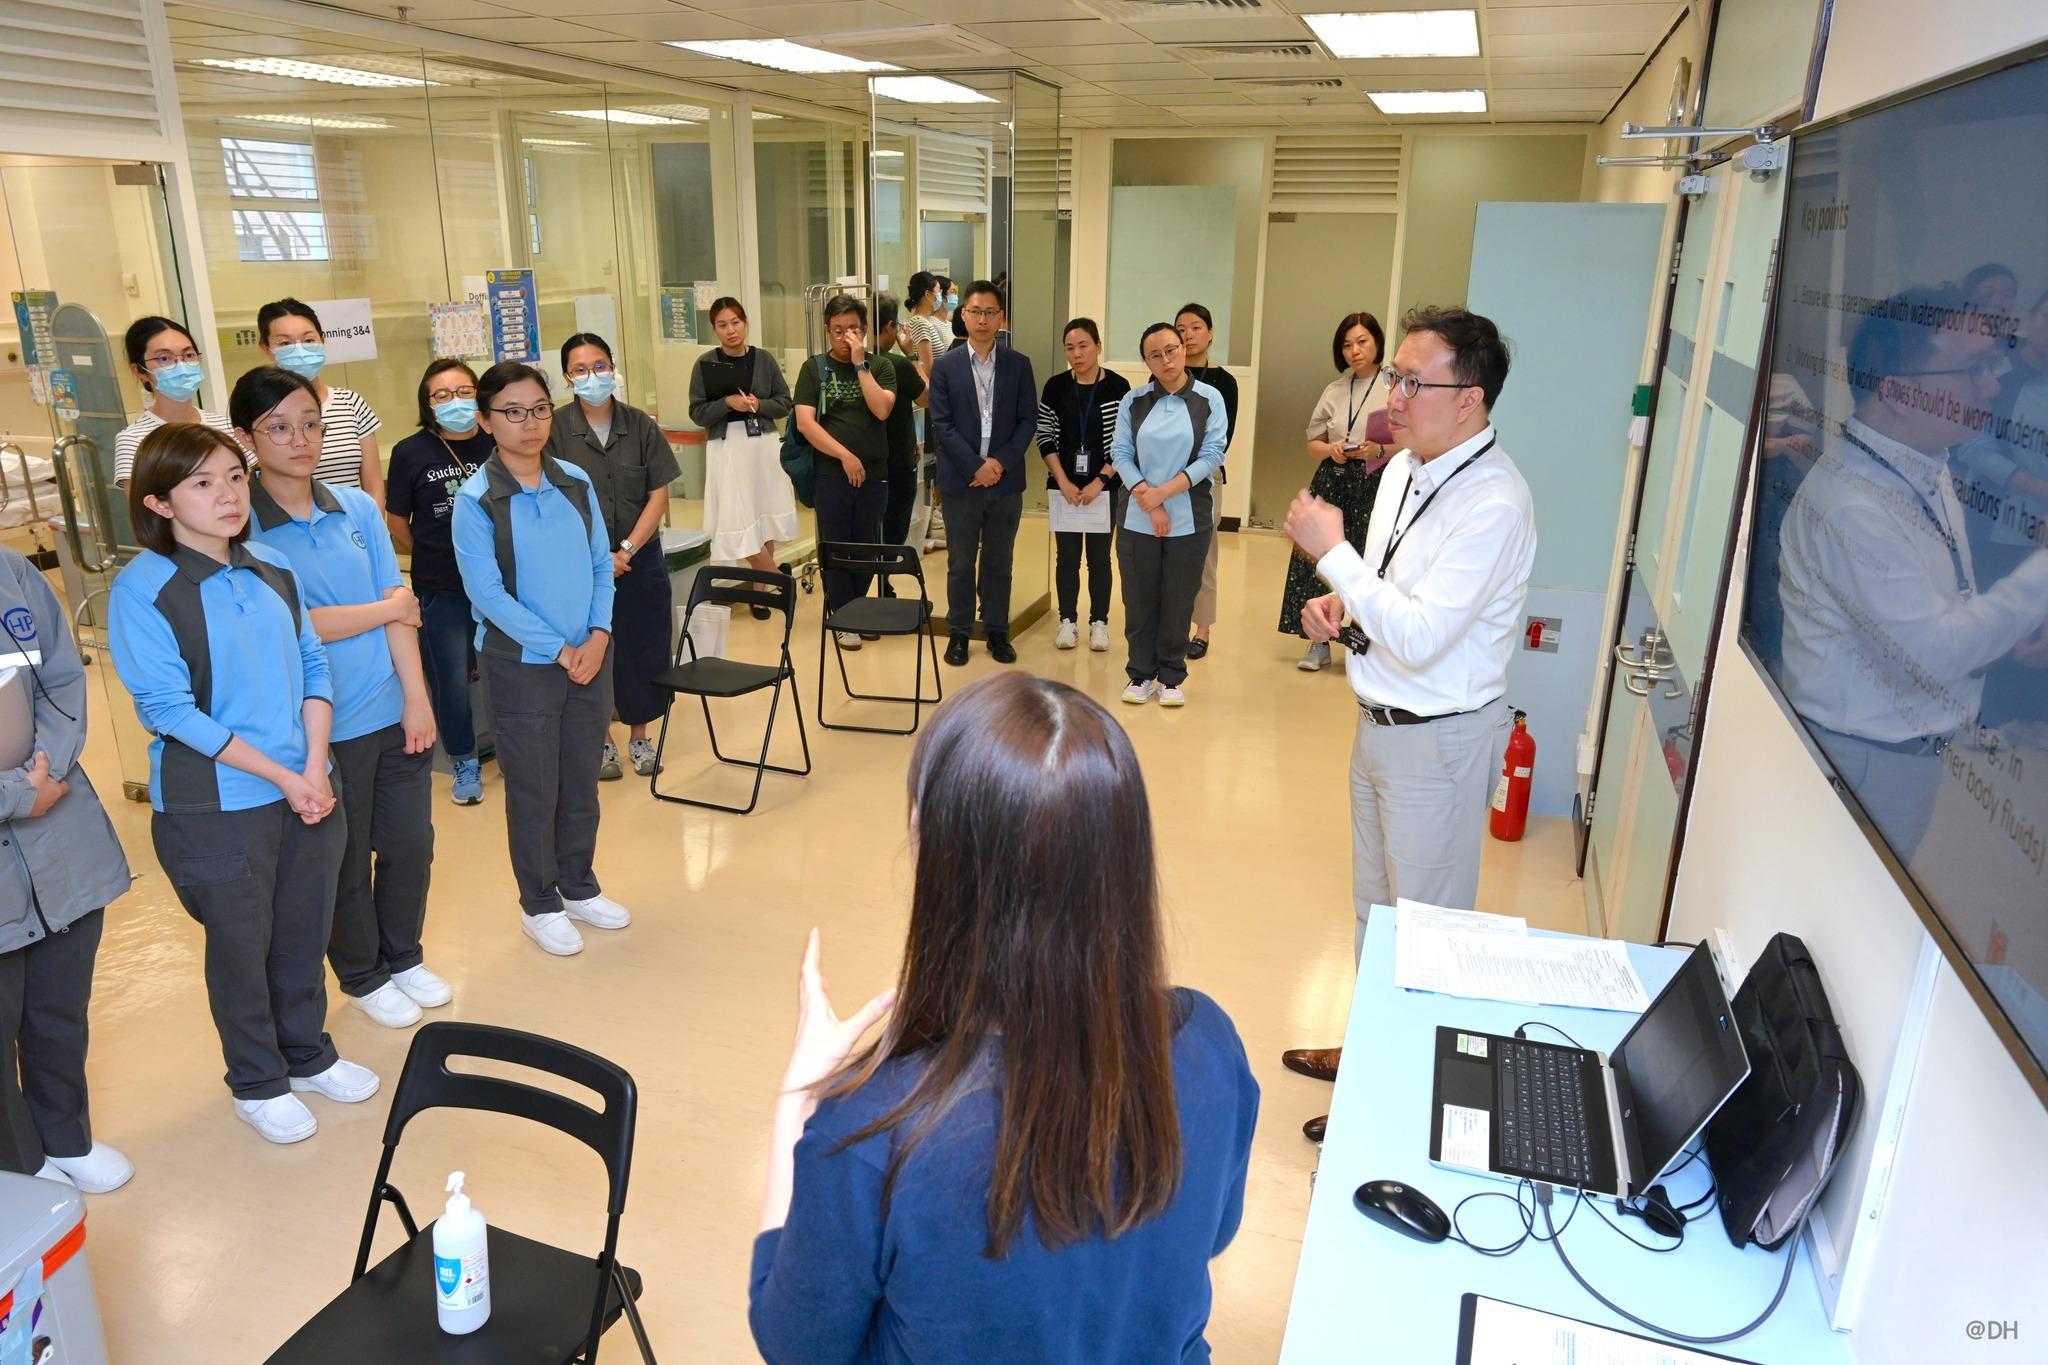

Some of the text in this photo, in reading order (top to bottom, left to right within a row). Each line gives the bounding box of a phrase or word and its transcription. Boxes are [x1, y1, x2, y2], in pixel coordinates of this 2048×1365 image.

[1801, 196, 1849, 240] Key points
[468, 291, 489, 301] Doffi
[1847, 295, 1858, 314] are
[1858, 294, 1889, 320] covered
[1889, 295, 1909, 323] with
[1911, 301, 1968, 334] waterproof
[1968, 303, 2021, 349] dressing
[320, 325, 370, 339] onning 3&4
[1856, 365, 1885, 402] working
[1886, 377, 1911, 407] shoes
[1911, 383, 1945, 419] should
[1946, 391, 1961, 424] be
[1963, 405, 1994, 434] worn
[427, 464, 462, 482] Lucky
[2002, 494, 2016, 529] in
[2017, 500, 2048, 550] han
[1890, 640, 1904, 666] on
[1904, 653, 1951, 712] exposure
[1951, 697, 1973, 736] risk
[1974, 711, 2006, 772] (e.g.,
[2007, 744, 2025, 784] in
[1934, 731, 1966, 782] other
[1965, 760, 2000, 826] body
[2000, 796, 2047, 876] fluids)
